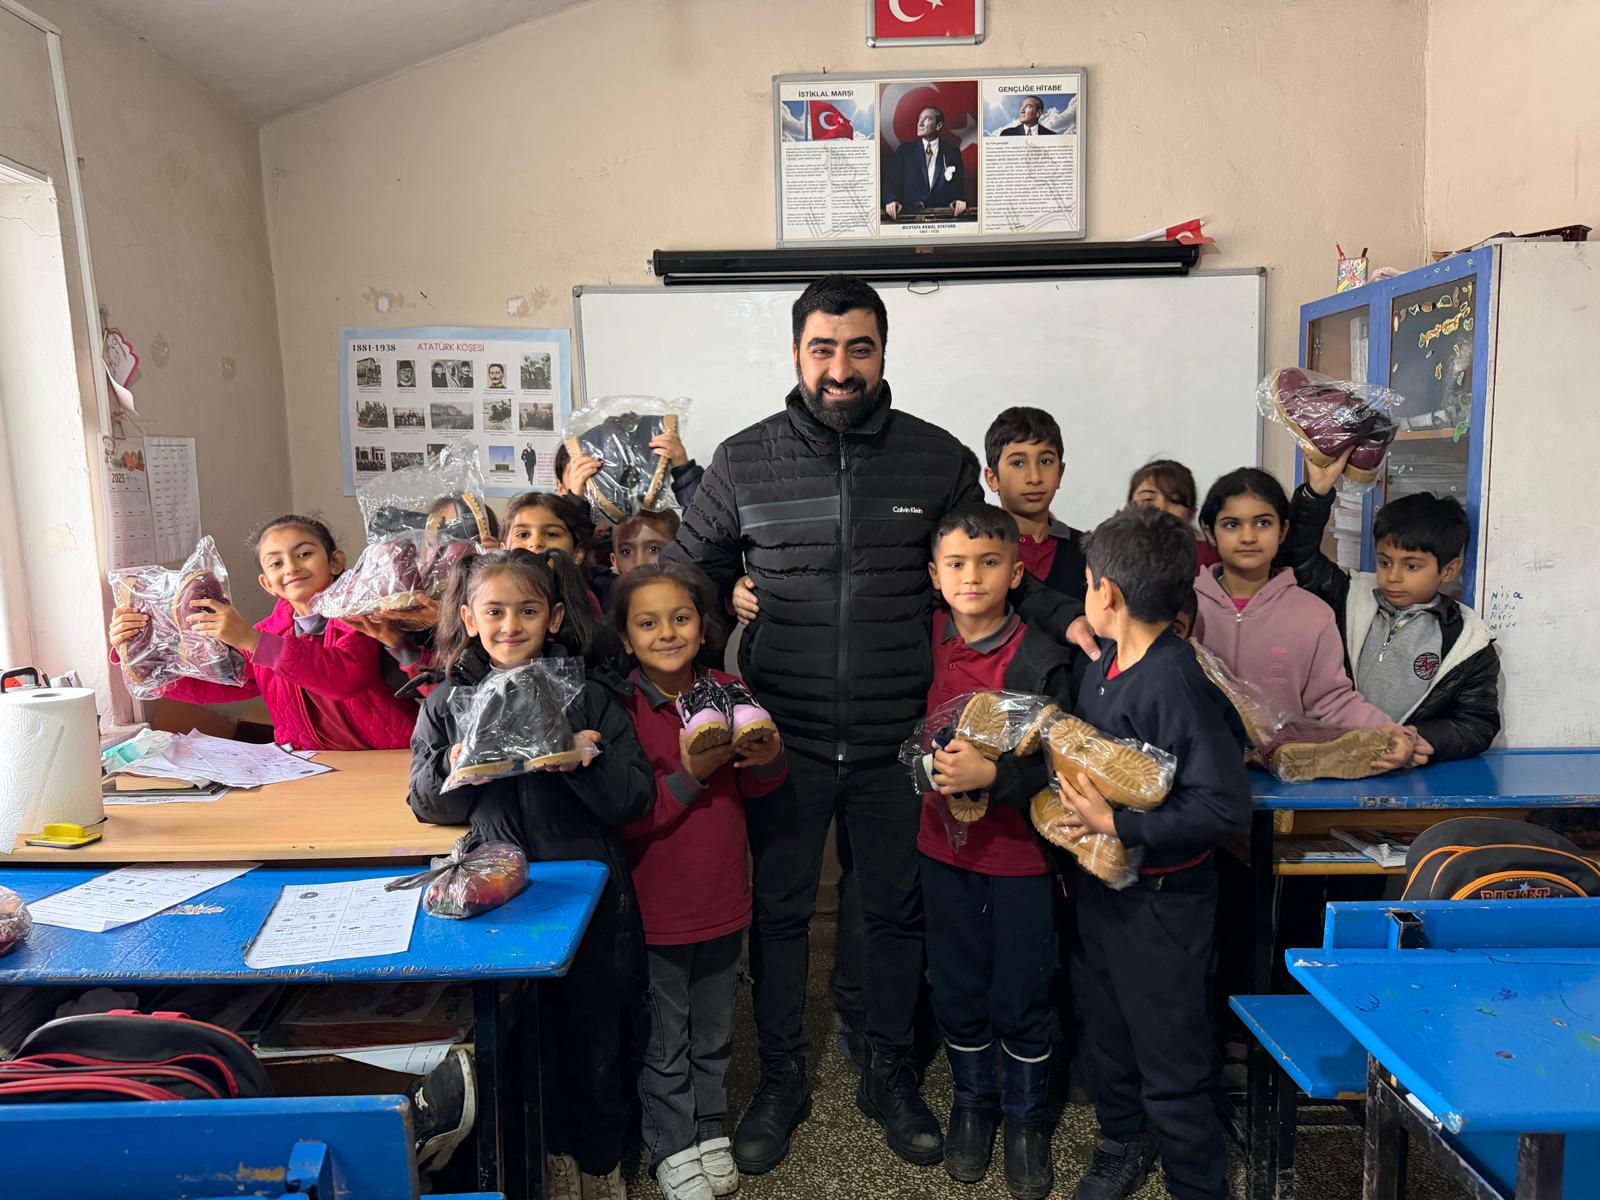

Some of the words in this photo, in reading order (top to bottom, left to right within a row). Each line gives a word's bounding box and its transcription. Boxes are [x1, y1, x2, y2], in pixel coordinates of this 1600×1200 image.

[998, 84, 1035, 93] GENÇLİĞE
[1036, 84, 1062, 92] HİTABE
[798, 89, 829, 98] İSTİKLAL
[831, 90, 854, 98] MARŞI
[352, 344, 396, 352] 1881-1938
[417, 342, 454, 351] ATATÜRK
[456, 342, 485, 352] KÖŞESİ
[111, 472, 126, 483] 2025
[910, 506, 923, 514] Klein
